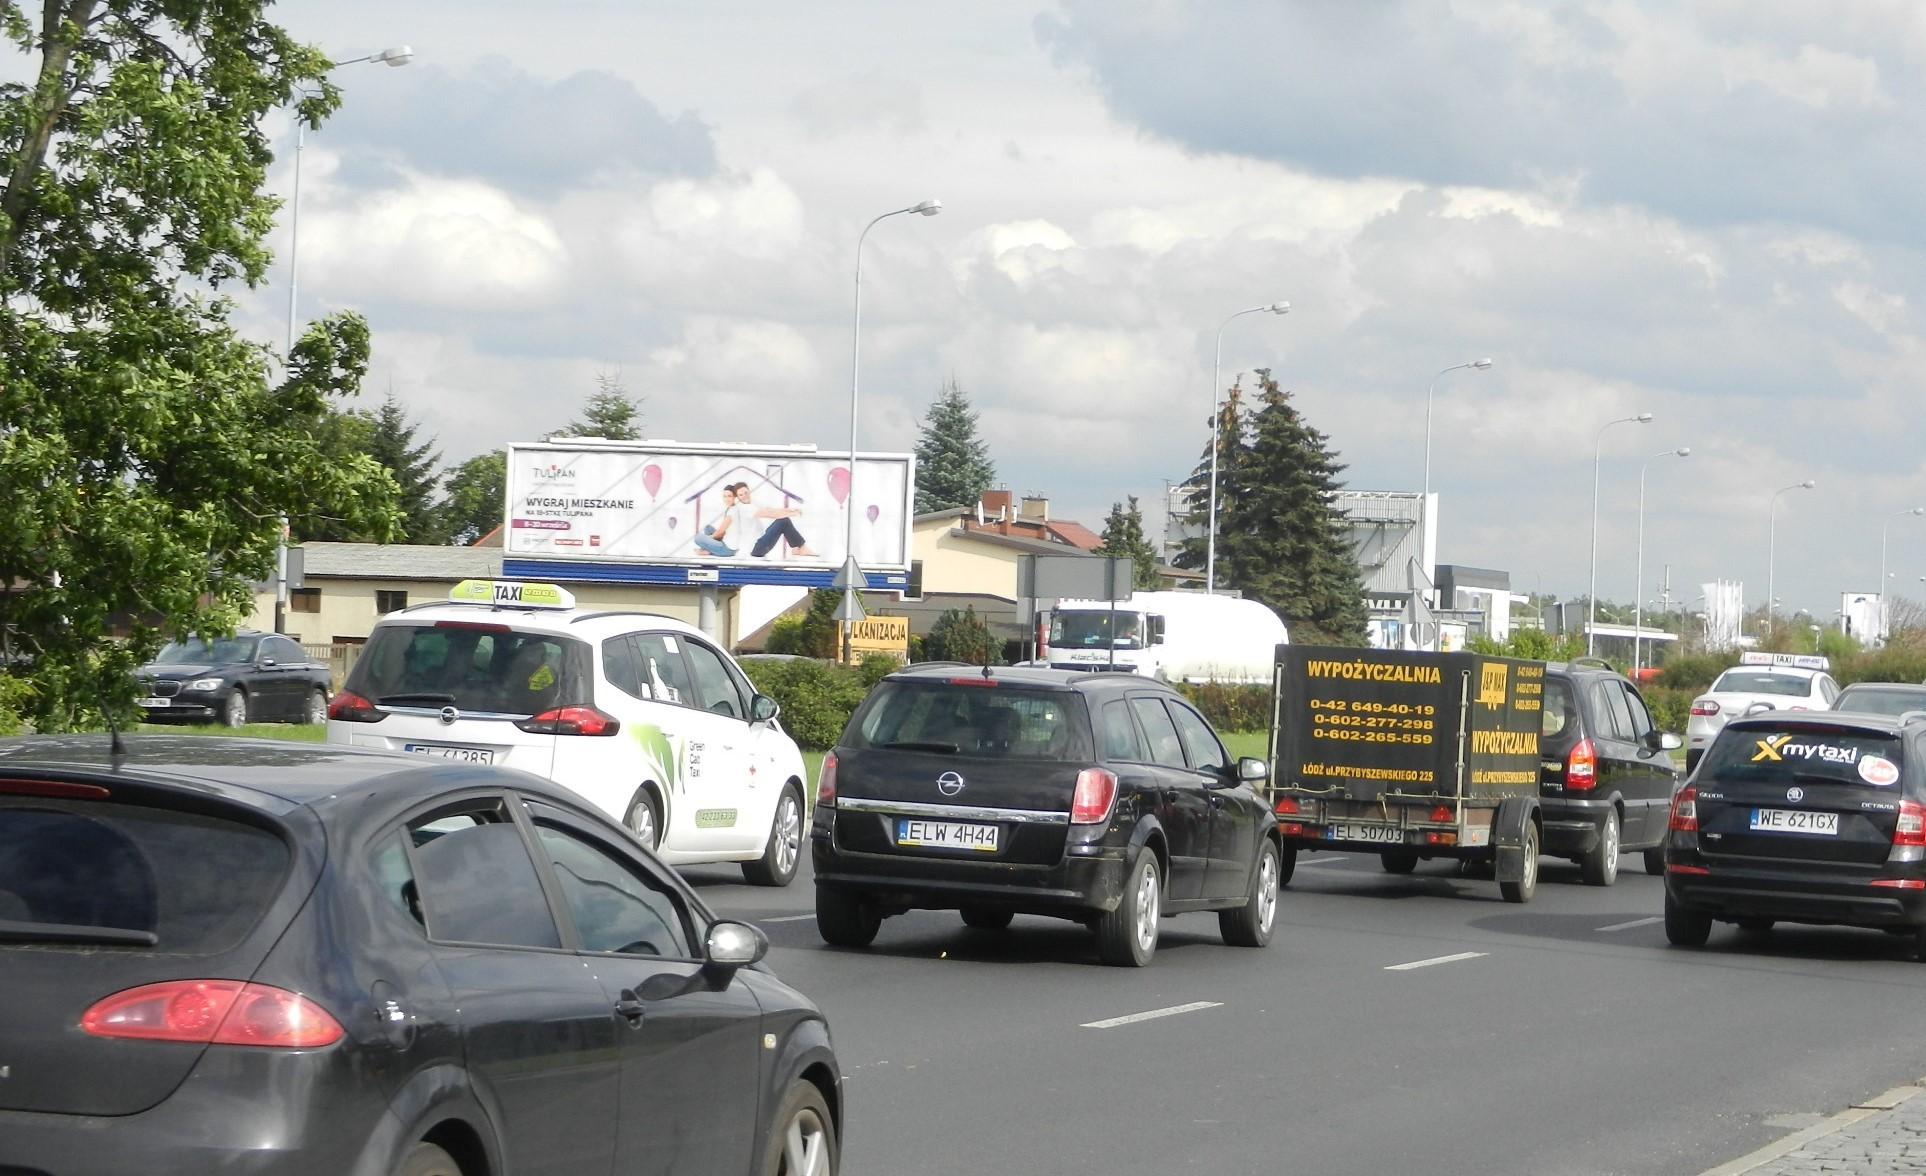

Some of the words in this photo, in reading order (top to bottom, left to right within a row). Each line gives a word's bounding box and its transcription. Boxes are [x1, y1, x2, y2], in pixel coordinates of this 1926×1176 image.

[526, 497, 569, 510] WYGRAJ
[571, 499, 634, 509] MIESZKANIE
[495, 586, 523, 600] TAXI
[1776, 655, 1792, 663] TAXI
[1308, 658, 1441, 683] WYPOŻYCZALNIA
[1310, 699, 1346, 711] 0-42
[1351, 702, 1435, 715] 649-40-19
[1314, 713, 1434, 730] 0-602-277-298
[1313, 728, 1433, 744] 0-602-265-559
[1472, 725, 1538, 754] WYPOŻYCZALNIA
[1782, 743, 1858, 762] mytaxi
[1419, 771, 1434, 782] 225
[1761, 811, 1782, 827] WE
[1788, 812, 1836, 829] 621GX
[910, 823, 947, 841] ELW
[954, 826, 995, 845] 4H44
[1336, 825, 1355, 839] EL
[1361, 826, 1402, 841] 50703
